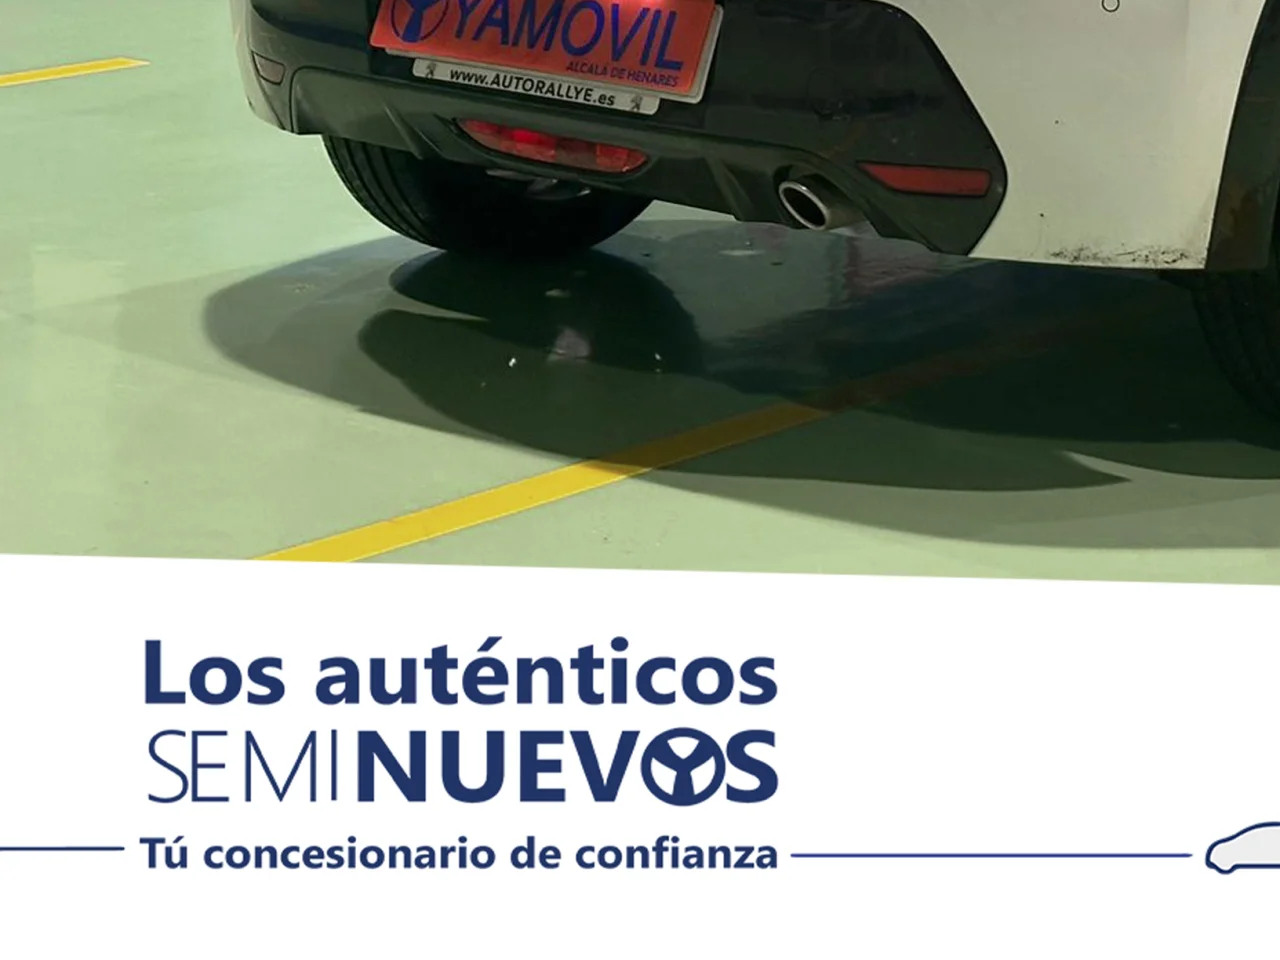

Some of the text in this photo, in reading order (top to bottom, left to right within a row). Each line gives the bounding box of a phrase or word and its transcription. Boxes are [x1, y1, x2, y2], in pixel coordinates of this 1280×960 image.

[450, 67, 615, 107] www.AUTORALLYE.es
[610, 67, 625, 79] DE
[627, 70, 679, 87] HENARES
